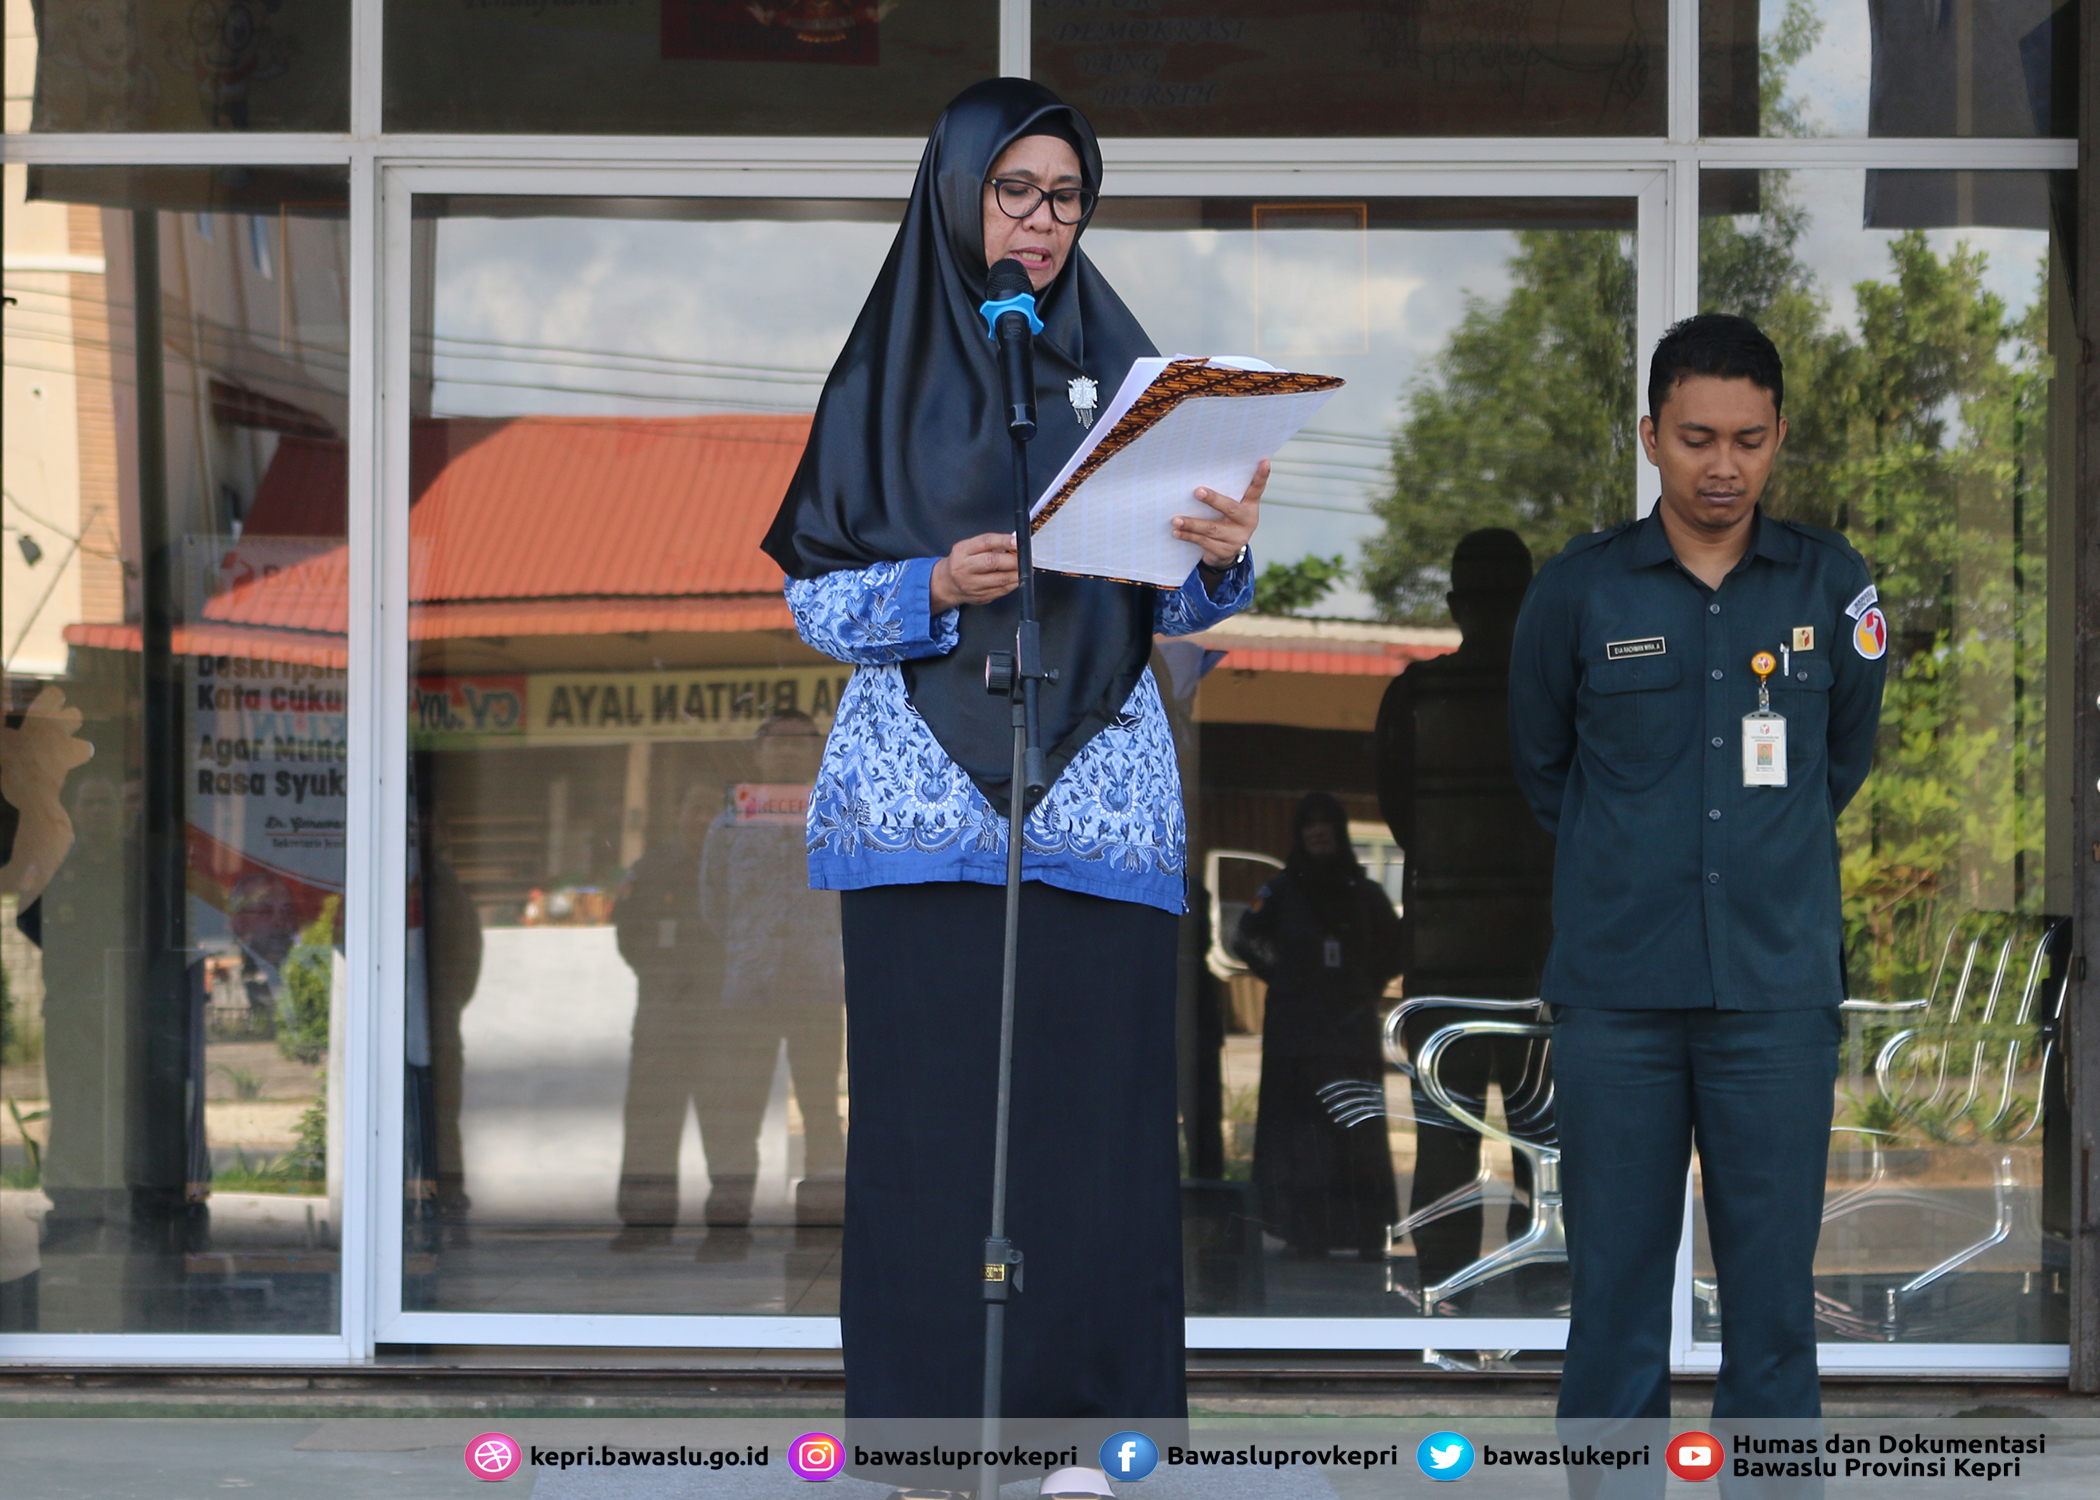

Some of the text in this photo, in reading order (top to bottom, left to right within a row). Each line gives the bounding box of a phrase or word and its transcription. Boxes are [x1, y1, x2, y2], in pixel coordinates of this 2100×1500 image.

[198, 684, 261, 710] Kata
[199, 734, 261, 766] Agar
[198, 768, 264, 794] Rasa
